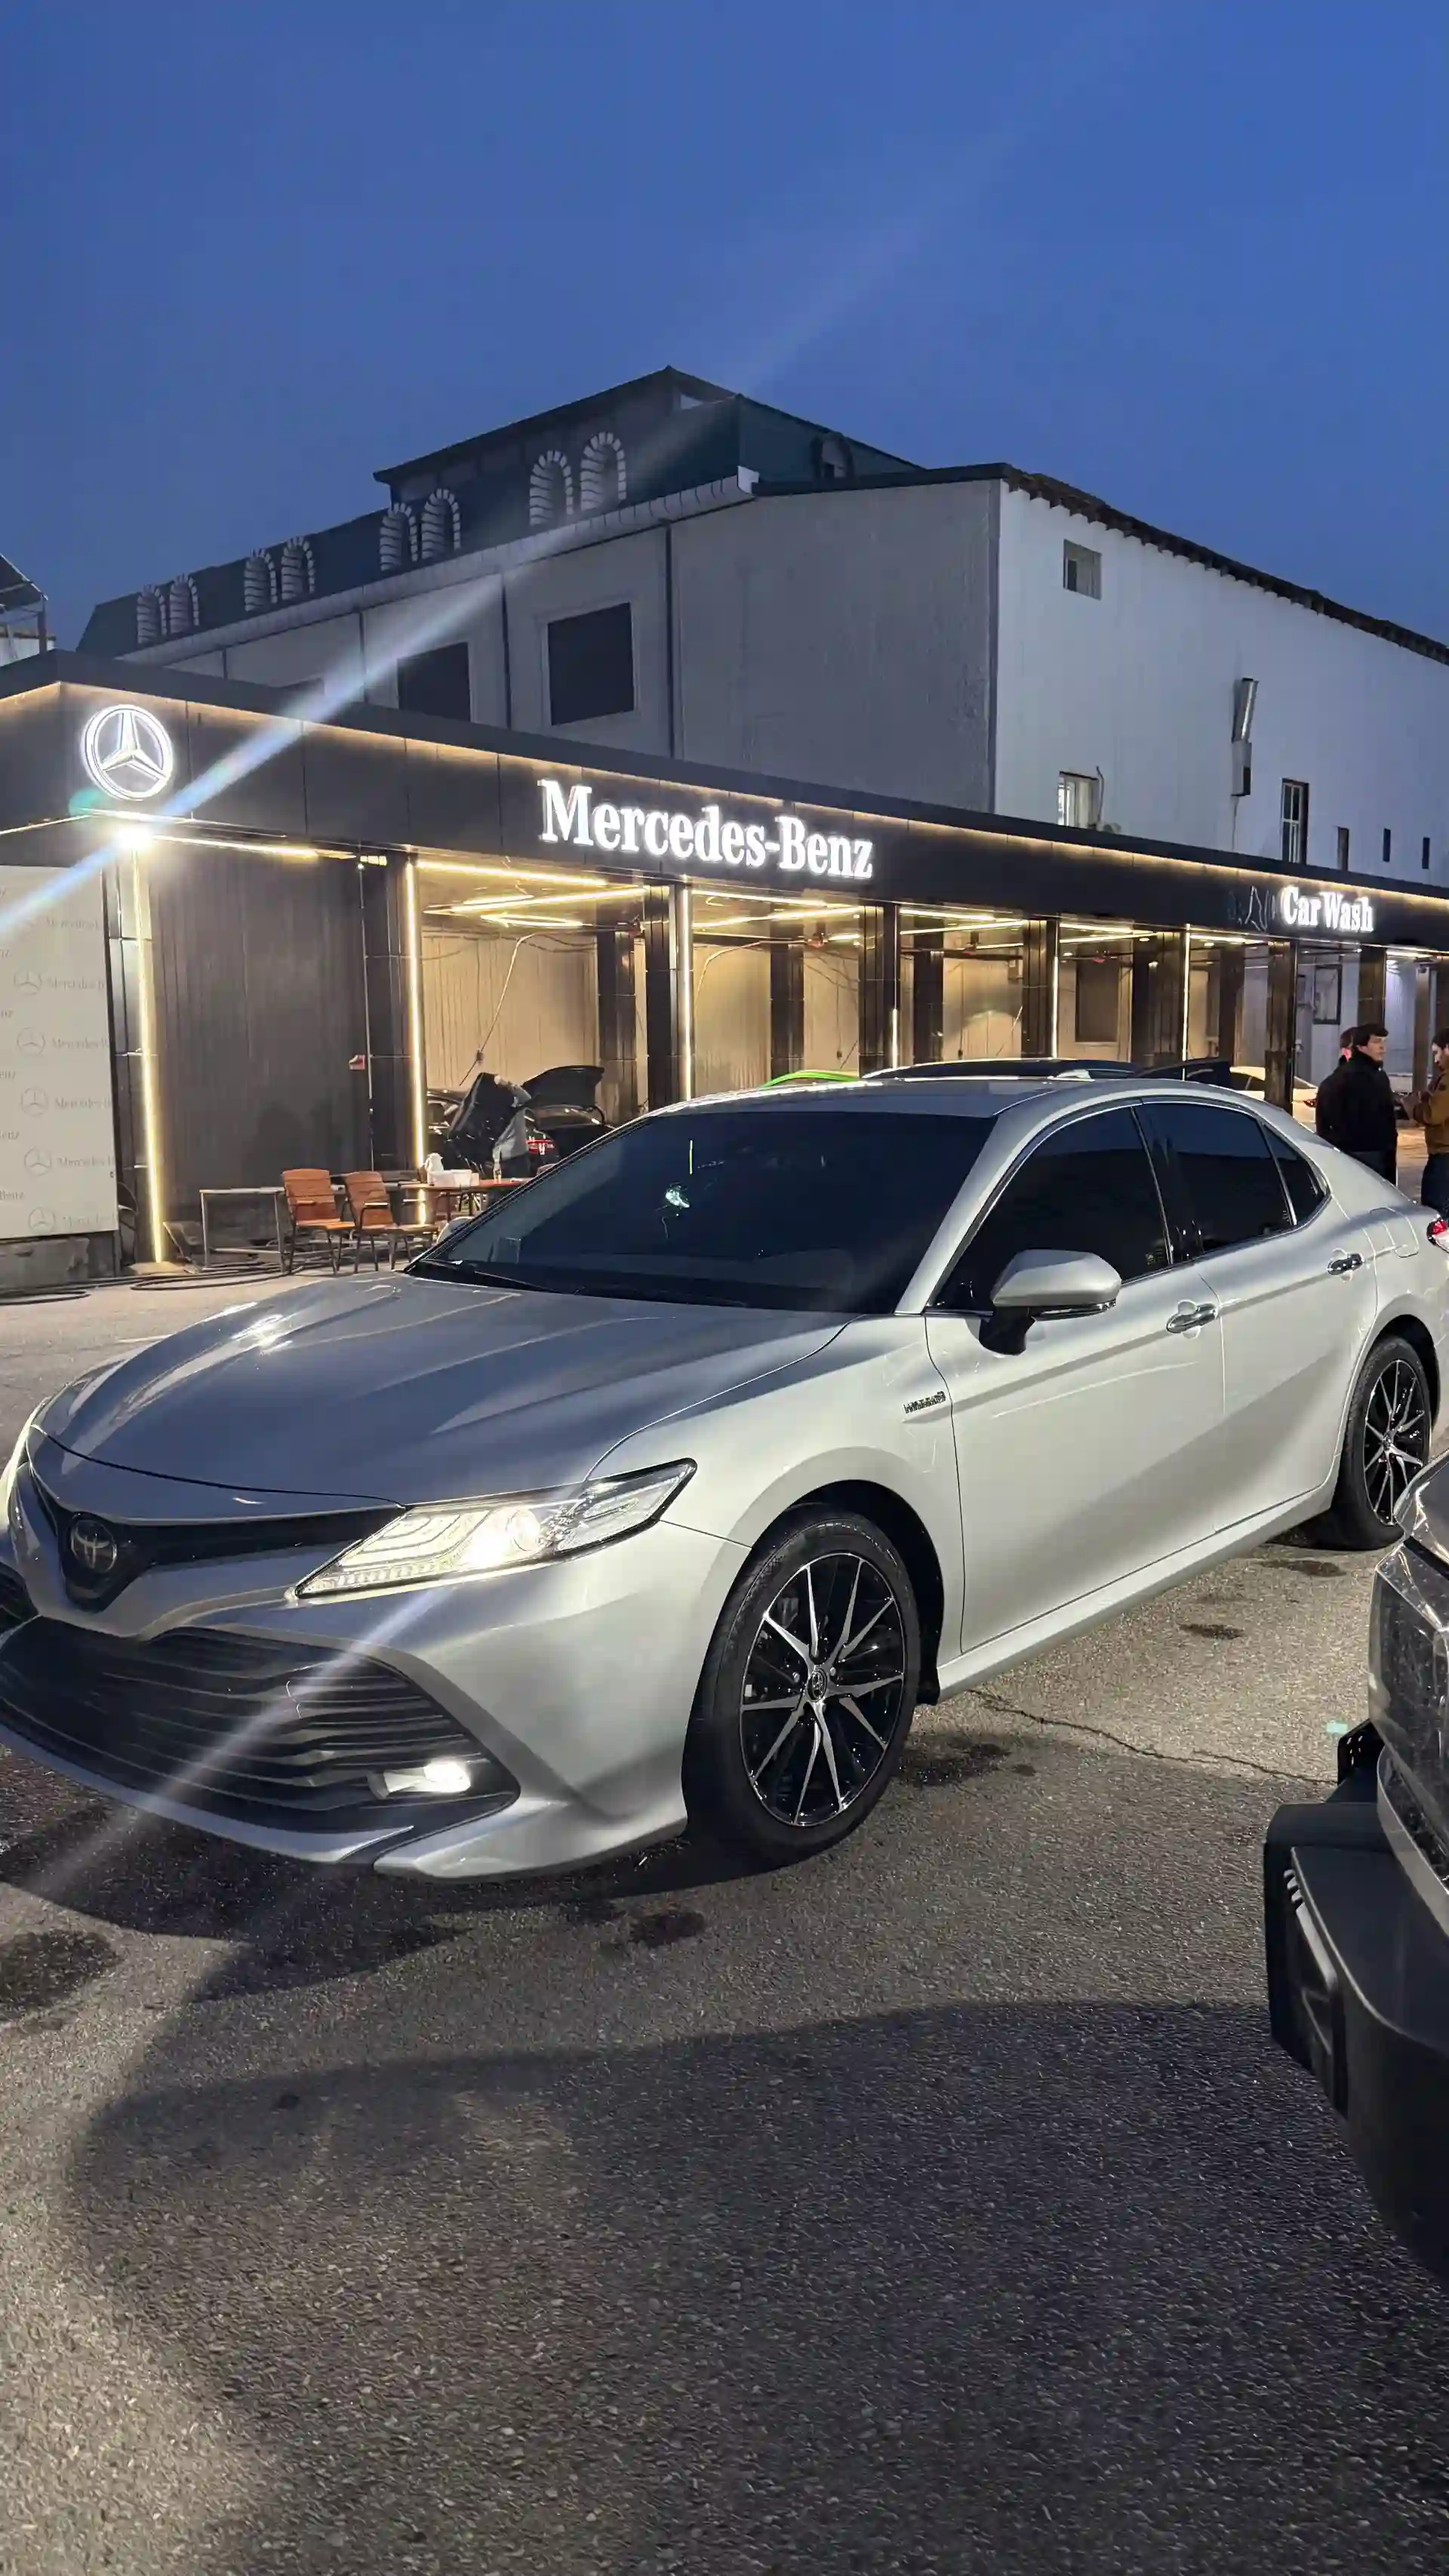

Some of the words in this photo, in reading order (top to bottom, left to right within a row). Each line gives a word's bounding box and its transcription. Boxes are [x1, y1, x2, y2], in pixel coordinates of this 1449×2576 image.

[537, 779, 873, 879] Mercedes-Benz
[1281, 886, 1321, 926] Car
[1319, 891, 1374, 933] Wash
